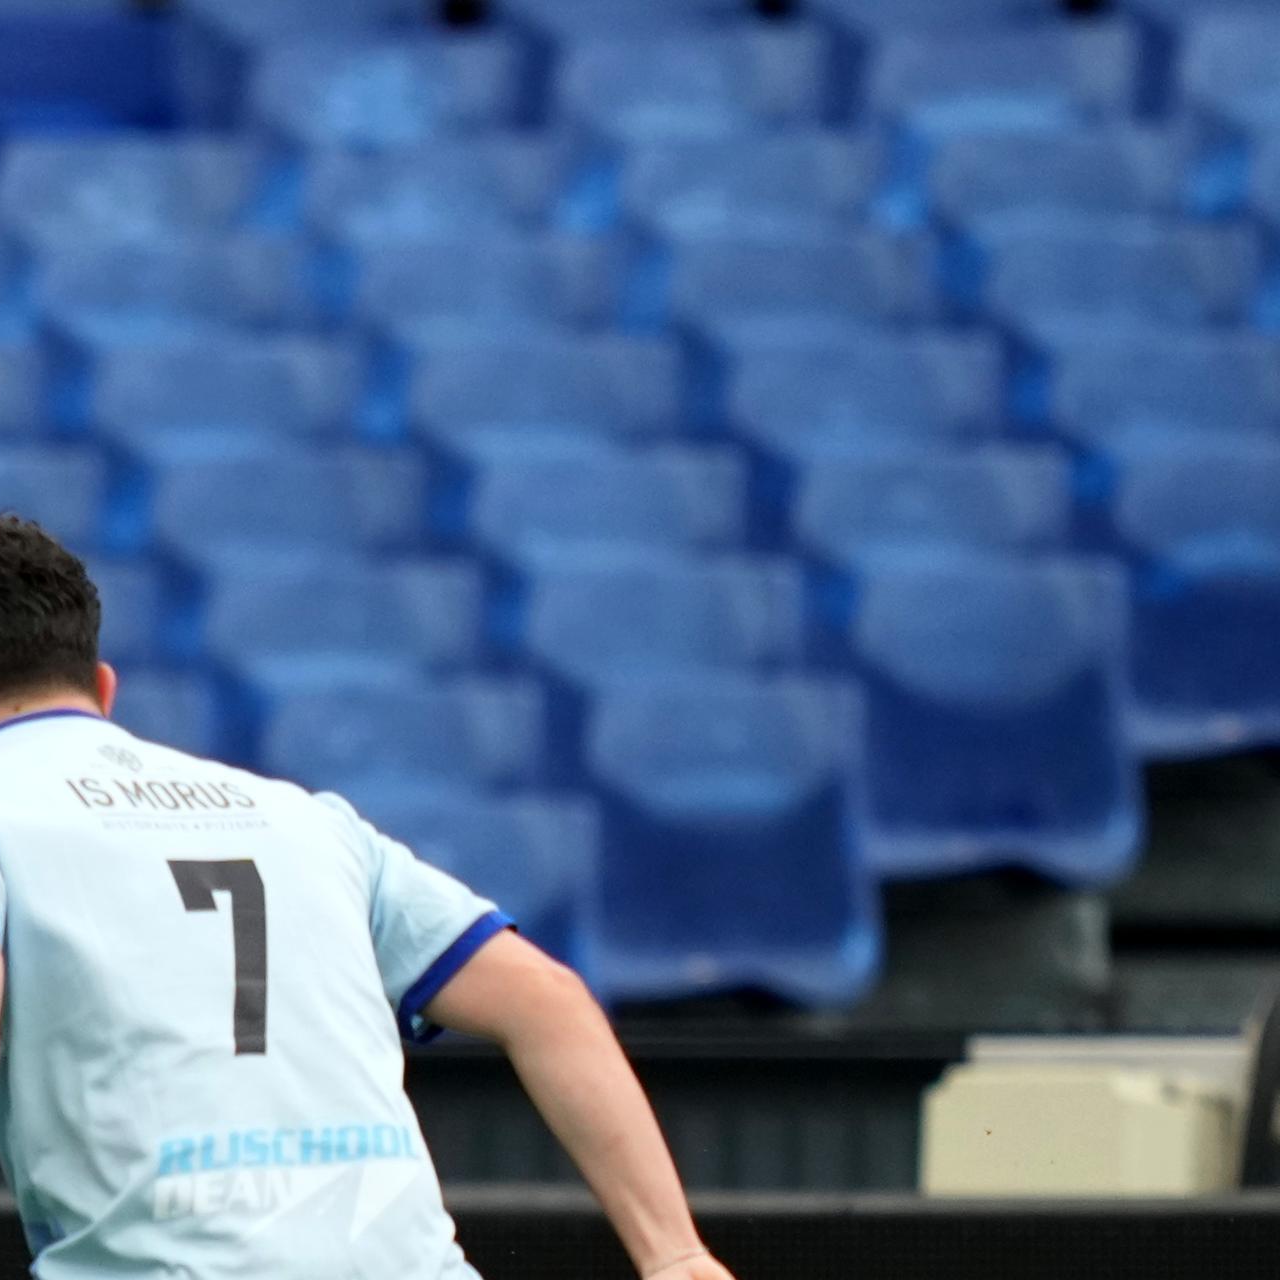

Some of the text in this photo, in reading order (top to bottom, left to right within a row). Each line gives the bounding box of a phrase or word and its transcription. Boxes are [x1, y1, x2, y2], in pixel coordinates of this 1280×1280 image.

[65, 776, 256, 811] IS MORUS
[166, 859, 267, 1056] 7
